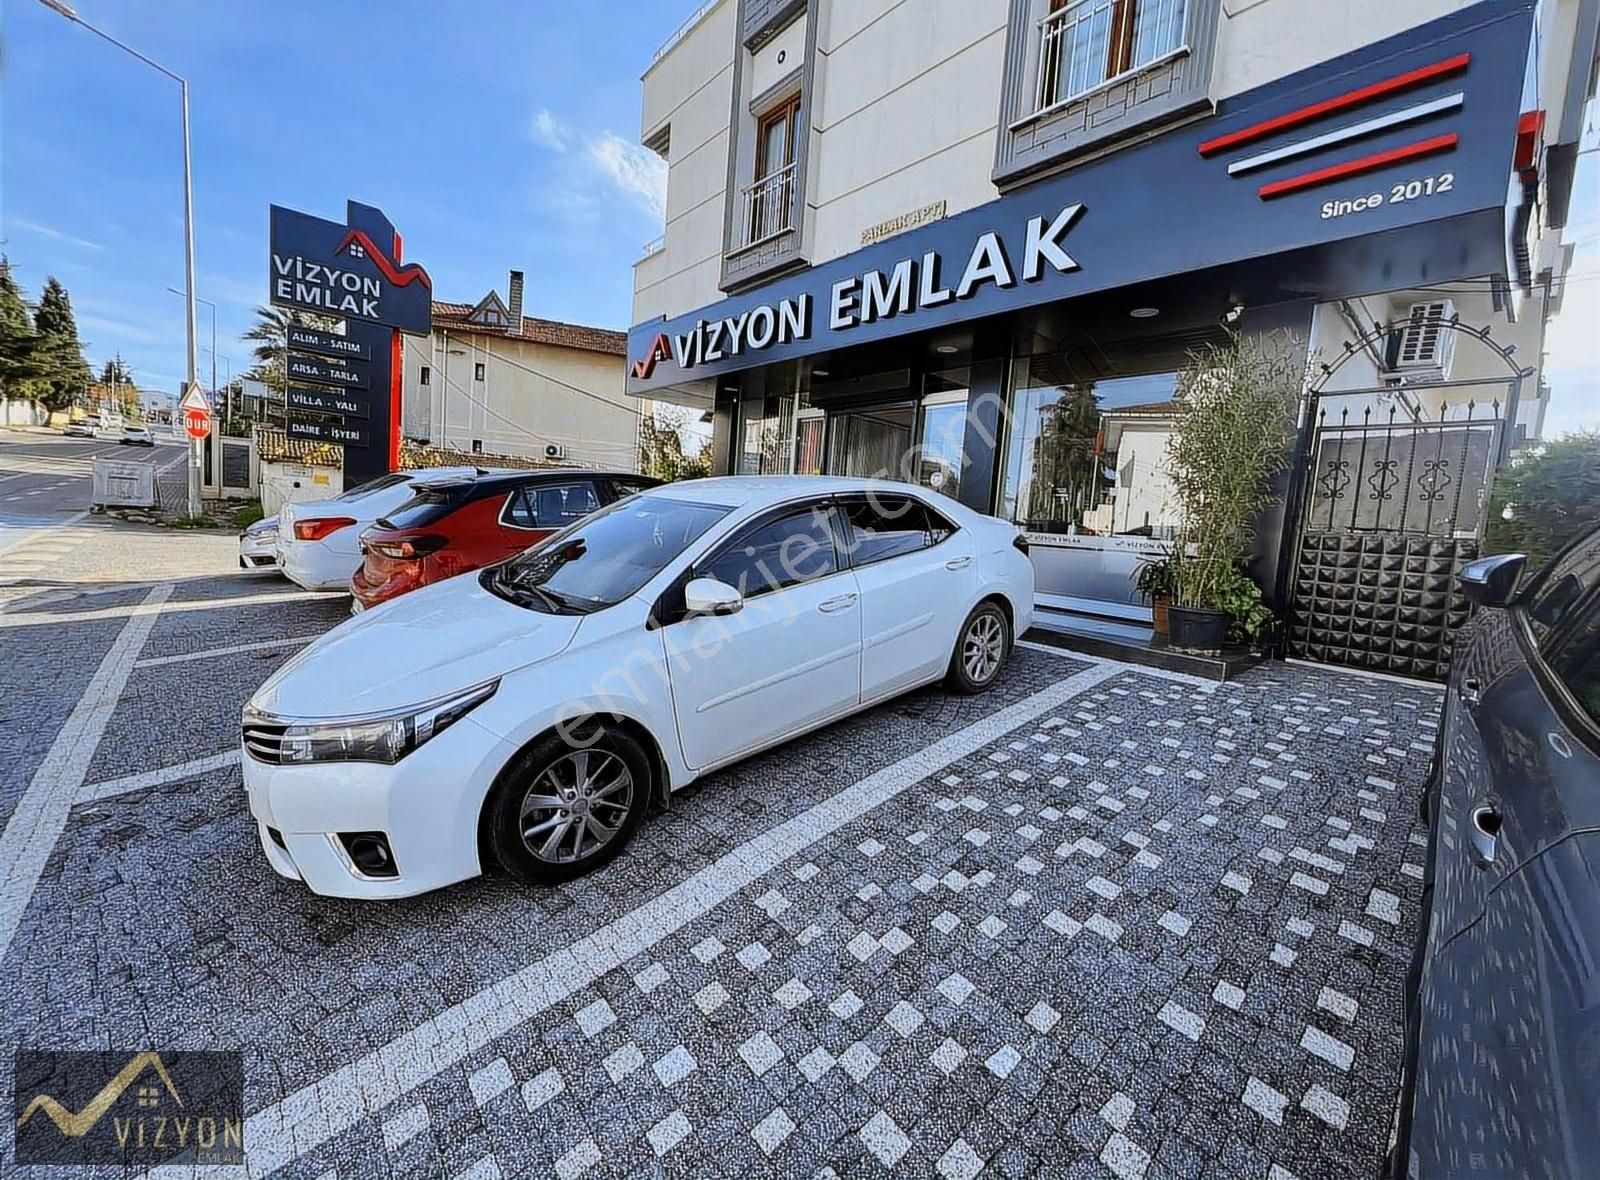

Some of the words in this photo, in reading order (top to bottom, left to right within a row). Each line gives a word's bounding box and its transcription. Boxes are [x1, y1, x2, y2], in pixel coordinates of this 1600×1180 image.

[1320, 193, 1383, 219] Since
[1390, 173, 1454, 204] 2012
[273, 254, 382, 299] VİZYON
[674, 292, 811, 368] VİZYON
[828, 202, 1087, 331] EMLAK
[276, 278, 379, 319] EMLAK
[292, 332, 319, 345] ALIM
[330, 339, 360, 353] SATIM
[292, 363, 319, 375] ARSA
[330, 369, 359, 382] TARLA
[335, 400, 357, 411] YALI
[186, 416, 209, 431] DUR
